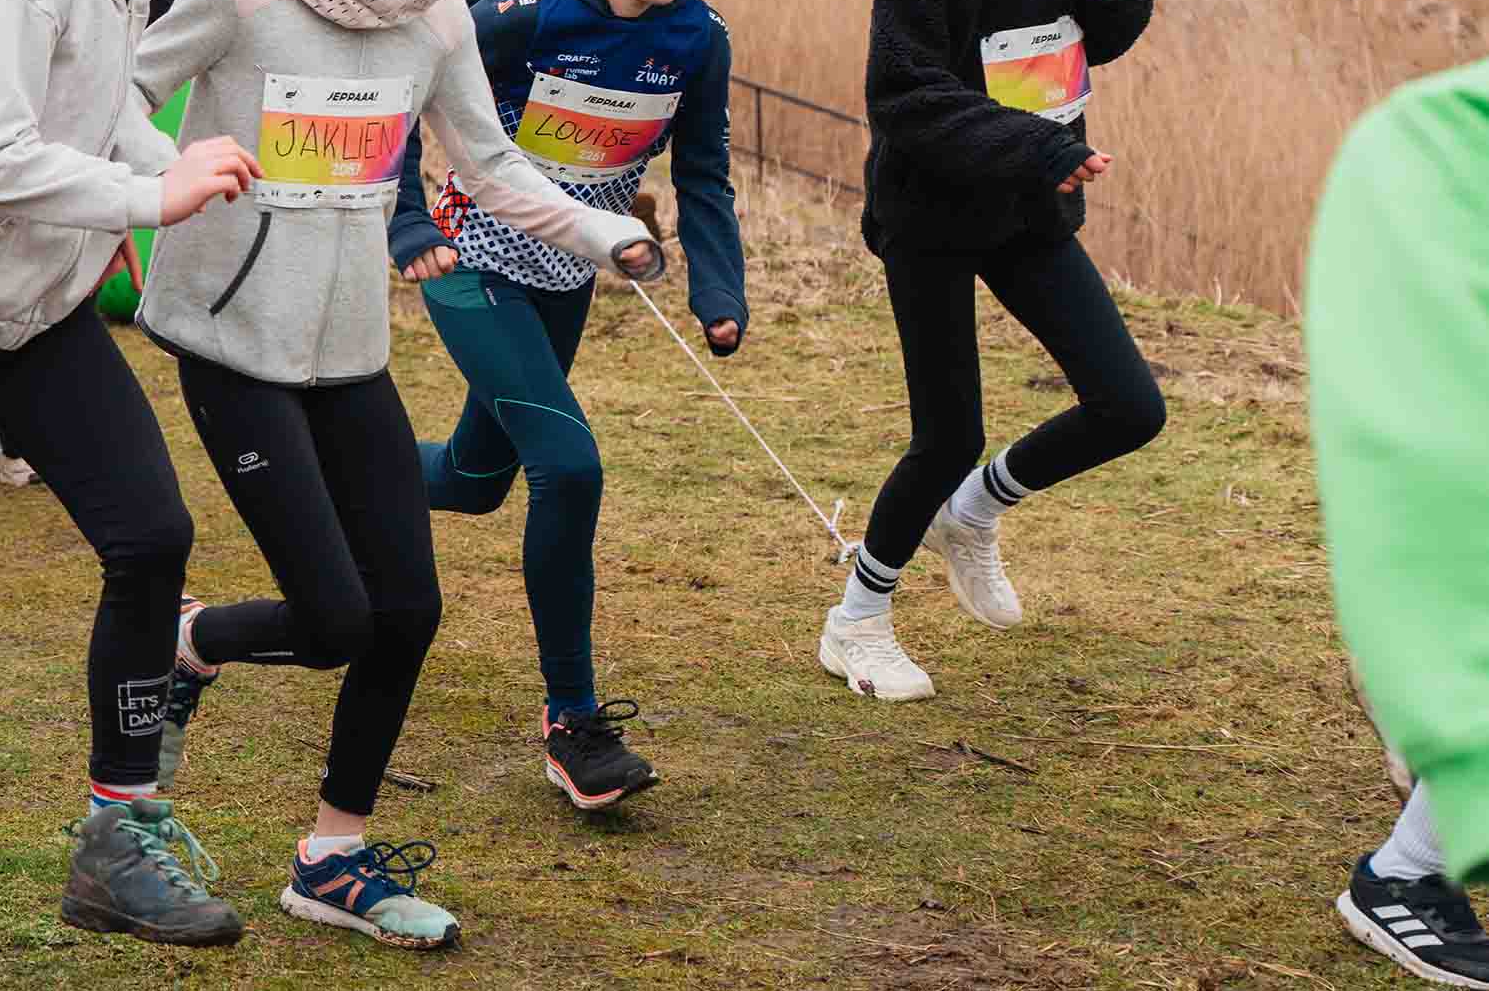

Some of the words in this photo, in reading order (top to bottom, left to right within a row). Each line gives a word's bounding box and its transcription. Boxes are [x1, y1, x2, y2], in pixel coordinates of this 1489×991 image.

[557, 53, 592, 63] CRAFT
[635, 69, 679, 87] ZWAT
[325, 91, 380, 102] JEPPAAA!
[583, 95, 637, 110] JEPPAAA!
[275, 119, 398, 161] JAKLIEN
